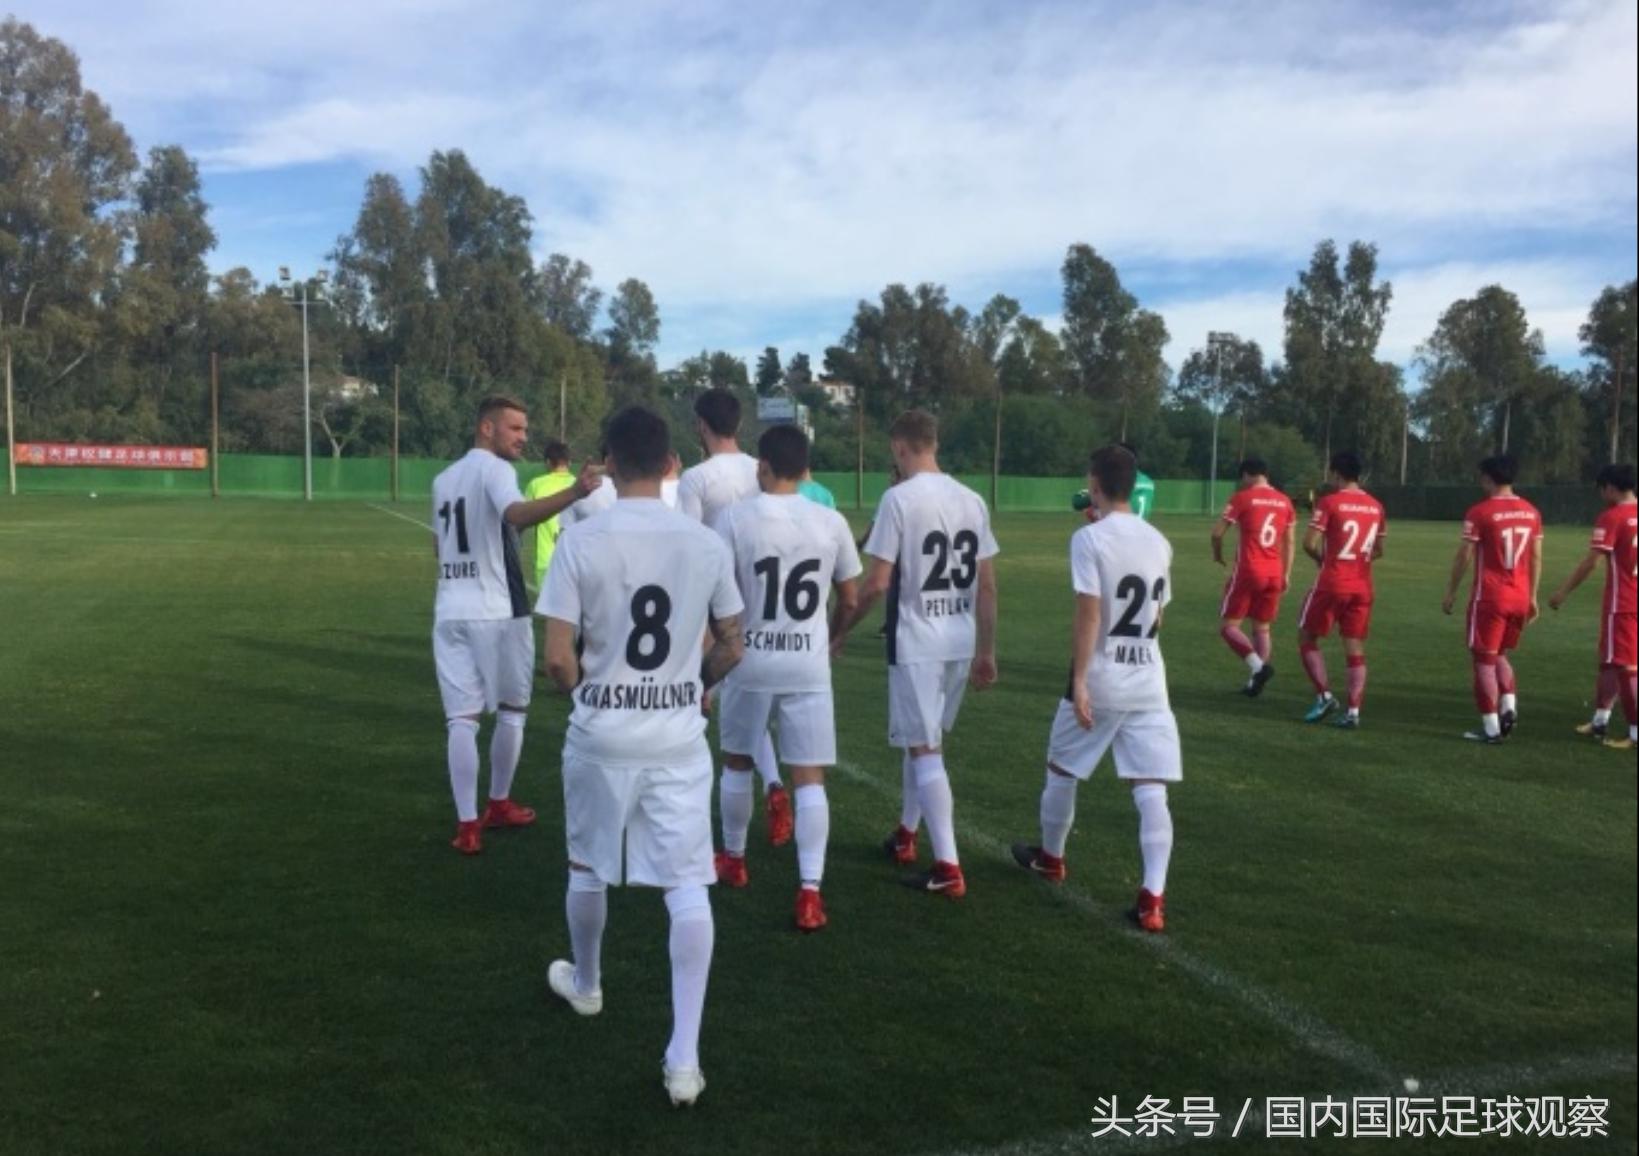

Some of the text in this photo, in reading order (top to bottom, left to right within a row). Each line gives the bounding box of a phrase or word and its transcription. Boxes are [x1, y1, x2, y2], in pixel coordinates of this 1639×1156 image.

[1260, 512, 1277, 548] 6
[1338, 520, 1379, 562] 24
[1502, 526, 1532, 570] 17
[921, 530, 979, 592] 23
[754, 556, 822, 622] 16
[626, 584, 671, 671] 8
[744, 630, 811, 652] SCHMIDT
